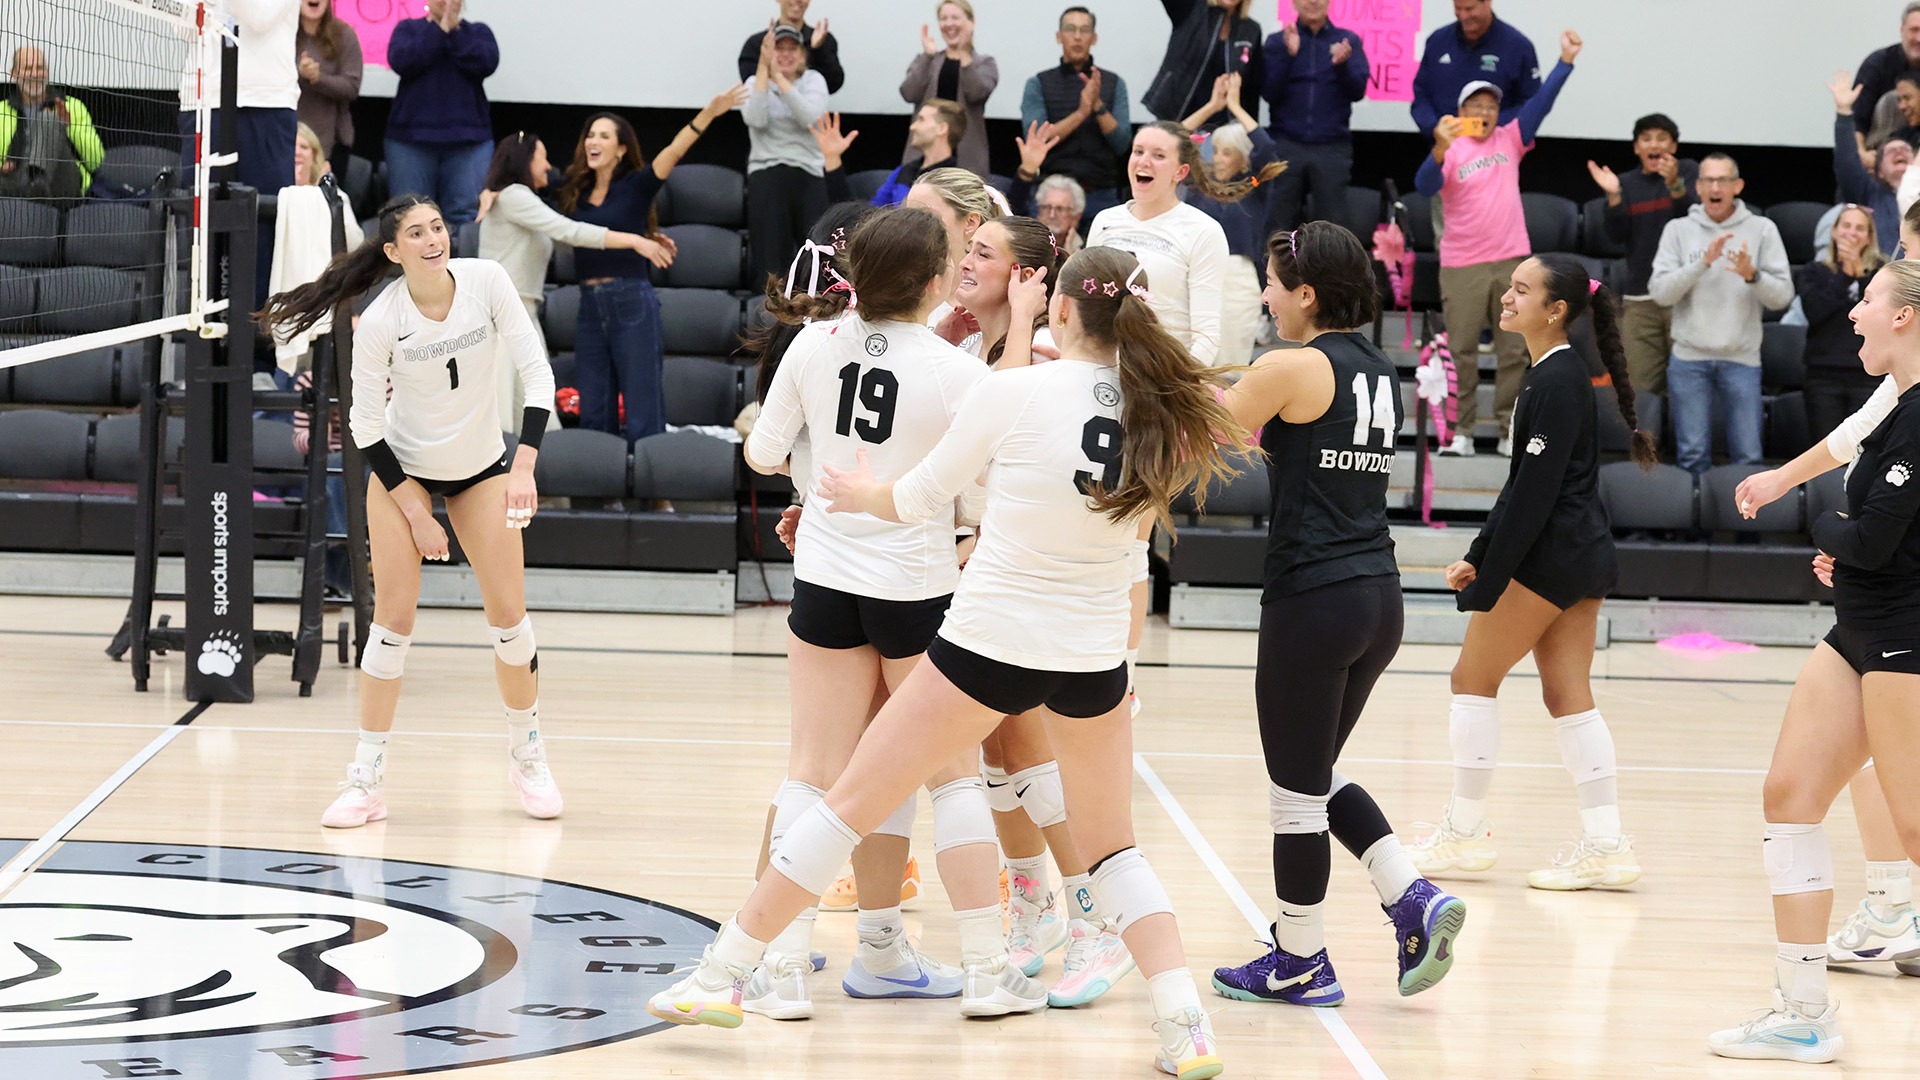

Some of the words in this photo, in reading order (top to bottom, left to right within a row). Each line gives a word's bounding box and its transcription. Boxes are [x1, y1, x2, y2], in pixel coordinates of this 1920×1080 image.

[402, 325, 487, 362] BOWDOIN
[446, 356, 459, 391] 1
[835, 361, 899, 445] 19
[1351, 372, 1396, 449] 14
[1073, 415, 1123, 497] 9
[211, 491, 230, 547] sports
[211, 548, 230, 616] imports
[136, 852, 676, 976] COLLEGE
